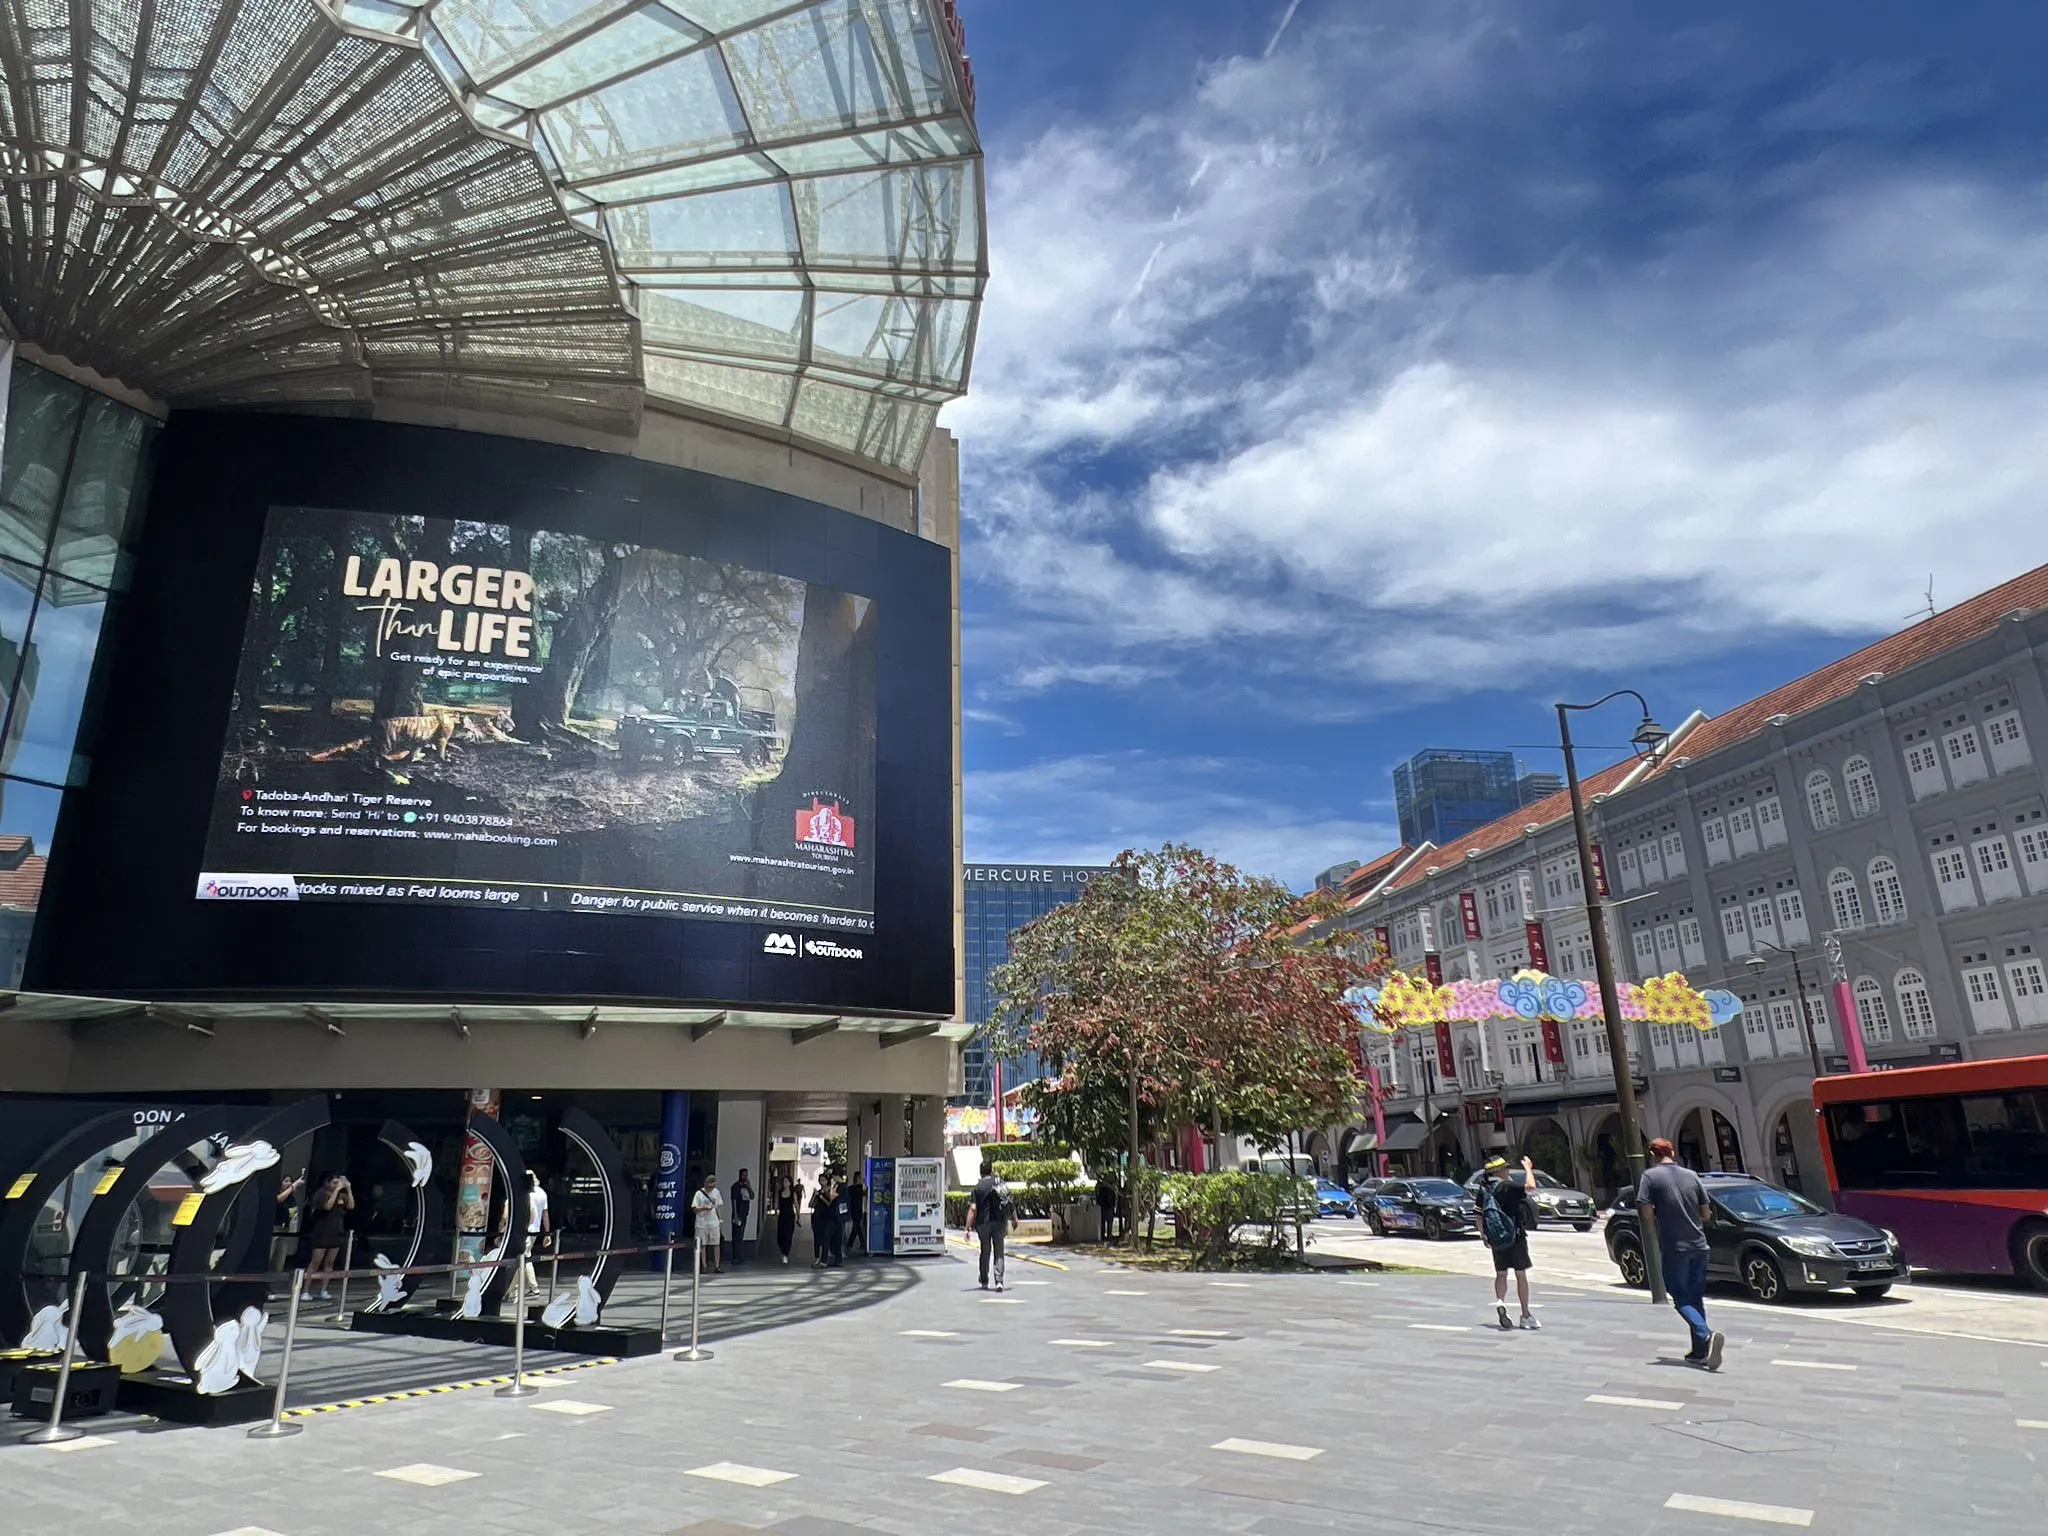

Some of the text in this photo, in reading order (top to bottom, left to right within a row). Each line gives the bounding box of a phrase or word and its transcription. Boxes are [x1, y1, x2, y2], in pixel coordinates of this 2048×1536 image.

[343, 555, 535, 612] LARGER
[356, 597, 534, 658] Than LIFE
[390, 652, 543, 674] Get ready for an experience
[422, 666, 435, 675] of
[438, 669, 461, 679] epic
[255, 790, 433, 807] Tadoba-Andhari Tiger Reserve
[240, 806, 254, 816] To
[257, 806, 290, 817] know
[292, 809, 328, 819] more:
[331, 809, 361, 820] Send
[387, 812, 400, 821] to
[418, 813, 439, 823] +91
[237, 823, 257, 833] For
[261, 823, 316, 836] bookings
[319, 825, 343, 836] and
[424, 831, 558, 847] www.mahabooking.com
[794, 842, 855, 858] MAHARASHTRA
[217, 886, 289, 898] OUTDOOR
[340, 883, 385, 896] mixed
[386, 887, 405, 897] as
[408, 885, 437, 898] Fed
[439, 886, 482, 900] looms
[484, 888, 519, 904] large
[570, 892, 620, 909] Danger
[621, 895, 639, 908] for
[641, 898, 679, 912] public
[681, 902, 724, 915] service
[727, 905, 758, 917] when
[760, 907, 768, 918] it
[770, 908, 819, 924] becomes
[857, 918, 868, 928] to
[815, 945, 863, 959] OUTDOOR
